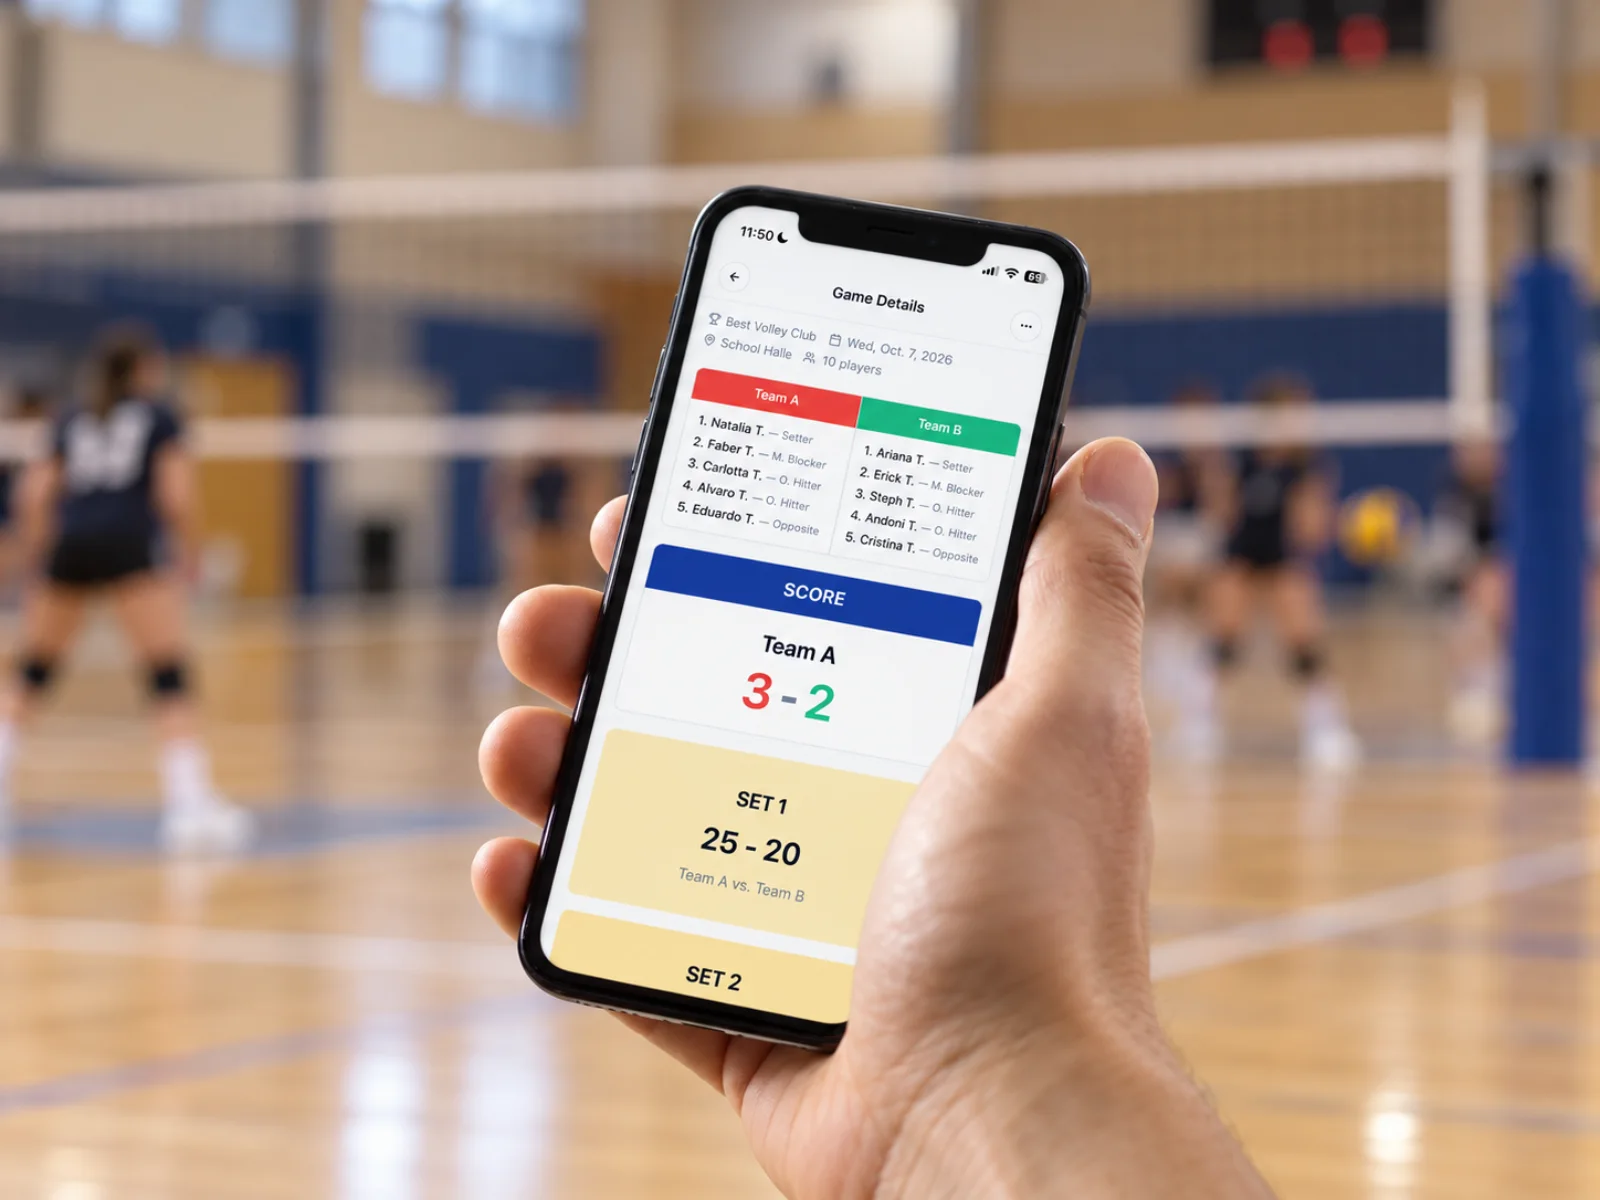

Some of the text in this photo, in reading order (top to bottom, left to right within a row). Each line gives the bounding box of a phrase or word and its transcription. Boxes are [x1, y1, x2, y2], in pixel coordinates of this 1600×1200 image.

[741, 226, 774, 241] 11:50
[1028, 272, 1042, 282] 69
[833, 287, 924, 313] Game Details
[726, 317, 816, 341] Best Volley Club
[721, 338, 792, 359] School Halle
[848, 338, 953, 365] Wed, Oct. 7, 2026
[823, 356, 882, 375] 10 players
[755, 388, 798, 405] Team A
[699, 415, 706, 426] 1.
[711, 417, 751, 434] Natalia
[756, 425, 764, 436] T.
[782, 431, 813, 444] Setter
[919, 418, 962, 435] Team B
[693, 436, 703, 447] 2.
[708, 439, 742, 454] Faber
[746, 445, 754, 456] T.
[772, 452, 784, 462] M.
[788, 454, 827, 469] Blocker
[865, 445, 872, 456] 1.
[876, 448, 912, 463] Ariana
[917, 454, 924, 465] T.
[942, 460, 973, 473] Setter
[688, 458, 698, 469] 3.
[703, 461, 748, 478] Carlotta
[753, 469, 761, 481] T.
[779, 475, 789, 485] O.
[793, 478, 821, 490] Hitter
[860, 467, 869, 477] 2.
[874, 469, 901, 483] Erick
[906, 475, 914, 486] T.
[931, 481, 942, 490] M.
[947, 483, 984, 498] Blocker
[683, 480, 693, 491] 4.
[697, 482, 735, 498] Alvaro
[739, 490, 747, 501] T.
[766, 496, 776, 505] O.
[780, 498, 810, 511] Hitter
[855, 488, 865, 499] 3.
[870, 491, 902, 506] Steph
[907, 497, 915, 508] T.
[932, 503, 942, 513] O.
[946, 506, 975, 518] Hitter
[677, 501, 687, 513] 5.
[692, 504, 741, 522] Eduardo
[746, 513, 754, 524] T.
[773, 519, 819, 535] Opposite
[850, 510, 860, 521] 4.
[865, 513, 905, 528] Andoni
[909, 520, 916, 531] T.
[934, 526, 944, 536] O.
[948, 528, 977, 541] Hitter
[845, 531, 855, 542] 5.
[860, 534, 903, 551] Cristina
[907, 542, 915, 553] T.
[933, 548, 978, 564] Opposite
[784, 583, 846, 606] SCORE
[764, 635, 835, 664] Team A
[742, 673, 834, 722] 3 - 2
[737, 791, 787, 814] SET 1
[701, 827, 739, 854] 25
[763, 839, 800, 865] 20
[680, 867, 805, 902] Team A vs. Team B
[686, 966, 741, 991] SET 2
